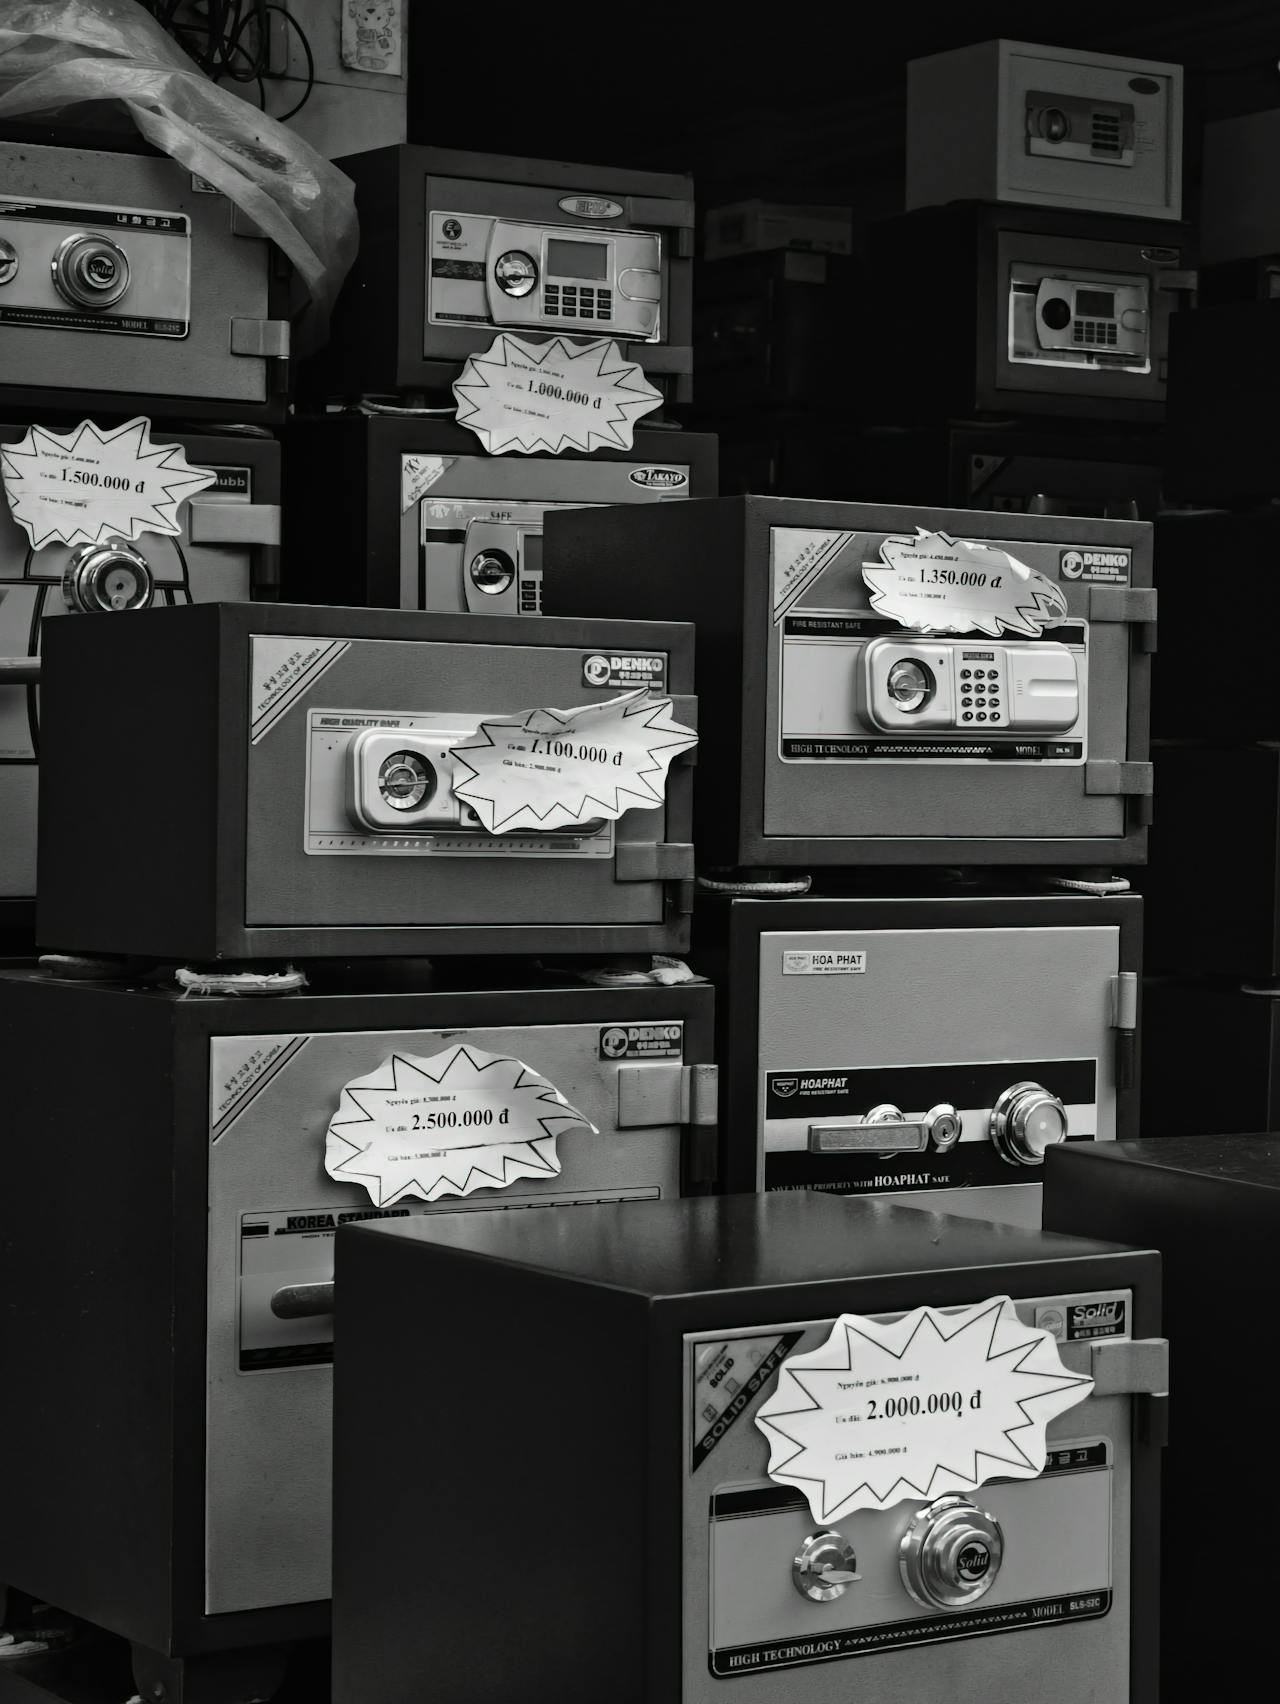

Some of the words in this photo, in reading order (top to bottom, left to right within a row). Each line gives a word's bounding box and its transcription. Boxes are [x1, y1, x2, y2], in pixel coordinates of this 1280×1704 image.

[528, 380, 588, 406] 1.000.000
[62, 468, 130, 491] 1.500.000
[216, 477, 246, 487] ubb
[1083, 552, 1128, 567] DENKO
[920, 568, 987, 588] 1.350.000
[611, 657, 664, 671] DENKO
[529, 738, 608, 764] 1.100.000
[612, 751, 623, 766] đ
[791, 744, 813, 754] HIGH
[815, 744, 869, 754] TECHNOLOGY
[1015, 746, 1043, 756] MODEL
[813, 955, 834, 965] HOA
[837, 955, 862, 965] PHAT
[628, 1027, 681, 1041] DENKO
[800, 1077, 848, 1089] HOAPHAT
[411, 1108, 493, 1131] 2.500.000
[499, 1108, 510, 1124] đ
[874, 1173, 930, 1187] HOAPHAT
[287, 1214, 336, 1230] KOREA
[1072, 1301, 1117, 1321] Solid
[710, 1357, 735, 1389] SOLID
[702, 1393, 748, 1451] SOLID
[747, 1343, 788, 1391] SAFE
[866, 1390, 963, 1420] 2.000.000
[970, 1389, 982, 1409] đ
[959, 1553, 989, 1569] Solid
[1031, 1603, 1065, 1618] MODEL
[729, 1652, 760, 1667] HIGH
[762, 1639, 842, 1662] TECHNOLOGY
